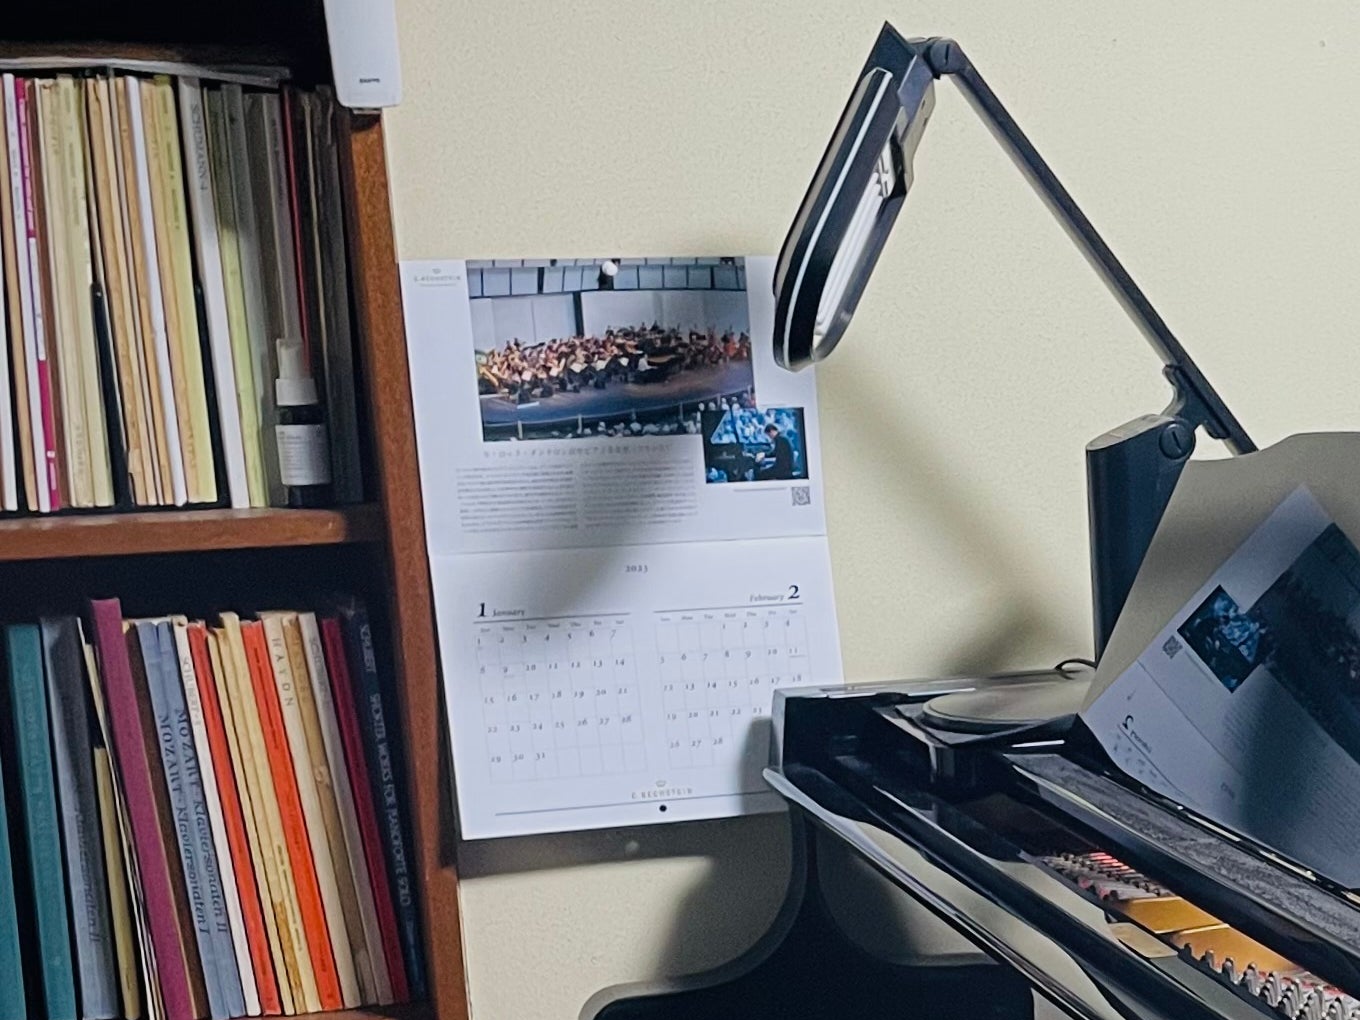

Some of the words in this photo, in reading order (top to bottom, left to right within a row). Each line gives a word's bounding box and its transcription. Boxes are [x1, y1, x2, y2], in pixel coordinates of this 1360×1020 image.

[478, 602, 486, 617] 1
[787, 584, 800, 599] 2
[175, 708, 200, 787] MOZART
[158, 714, 182, 793] MOZART
[176, 806, 206, 923] Klaviersonaten
